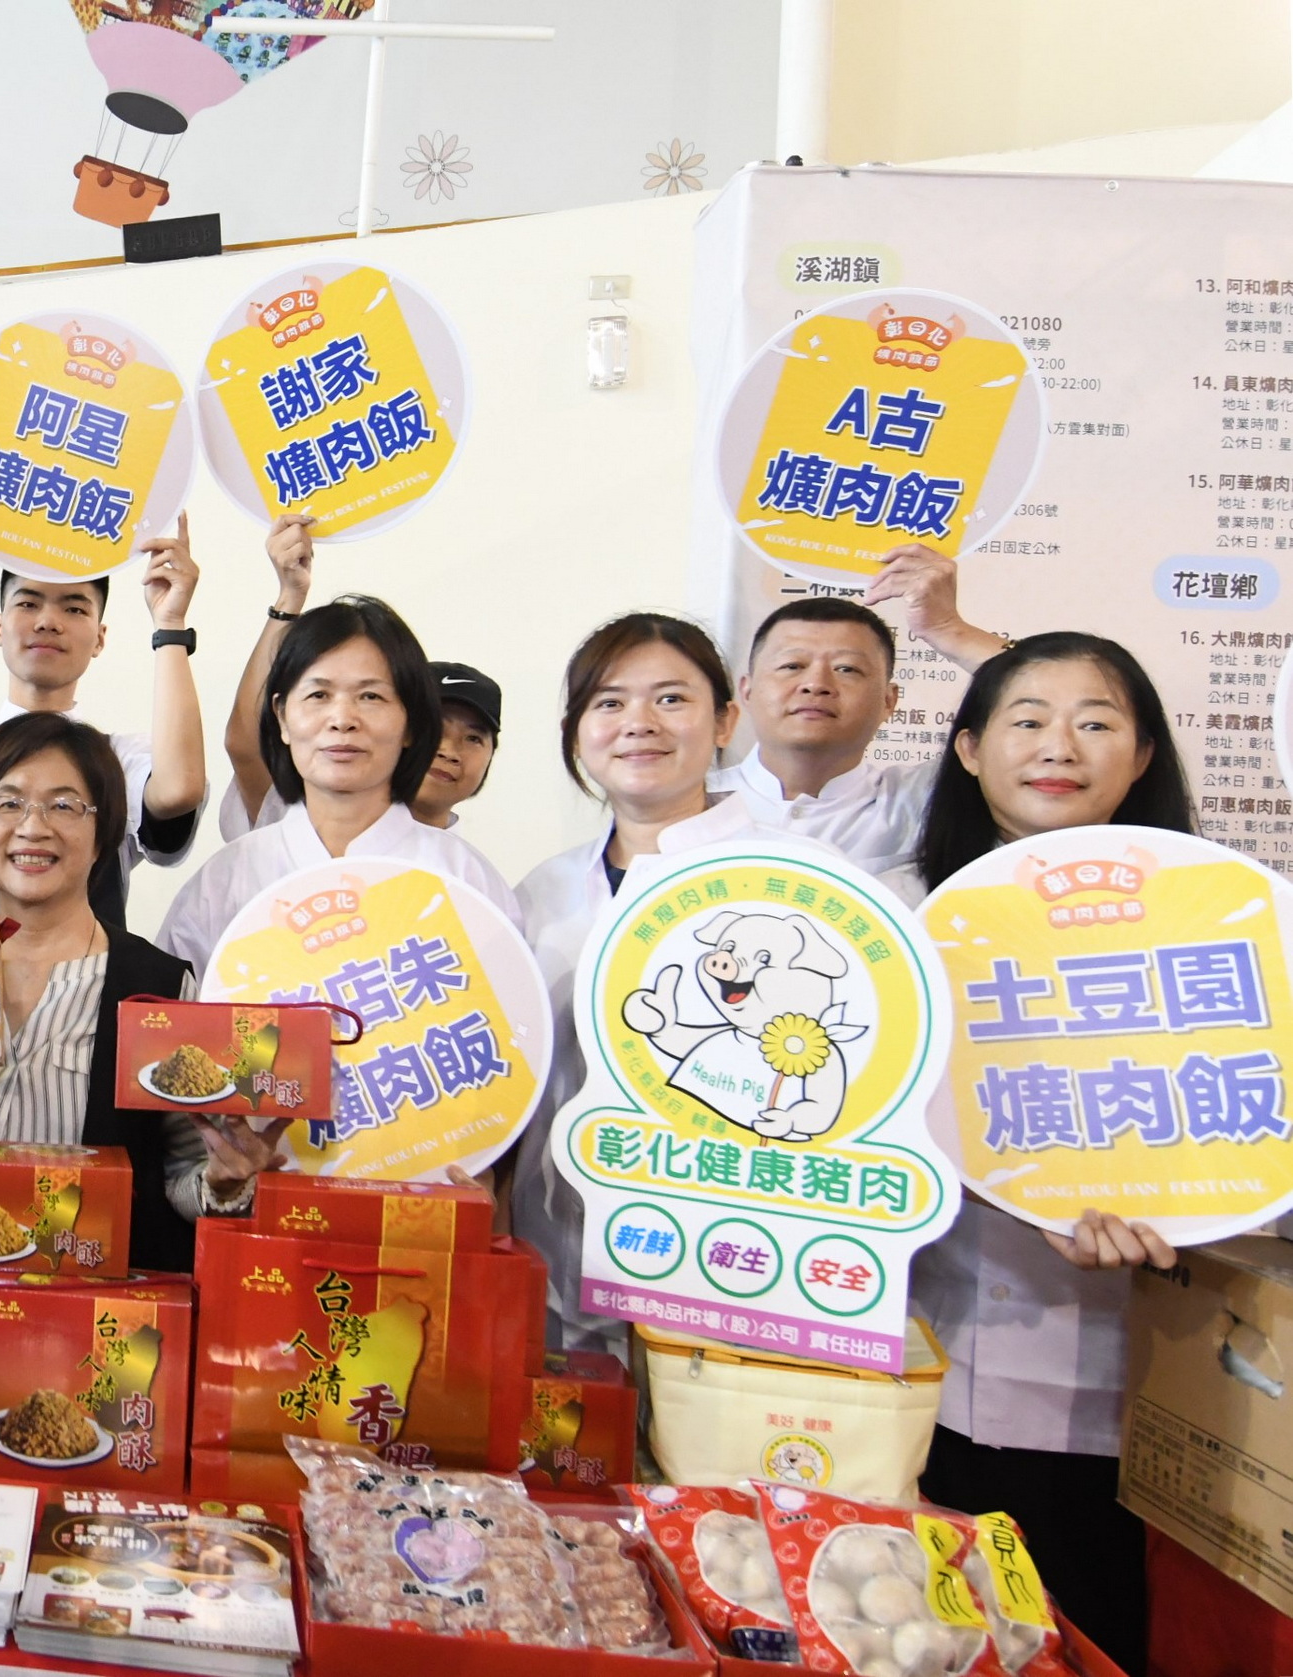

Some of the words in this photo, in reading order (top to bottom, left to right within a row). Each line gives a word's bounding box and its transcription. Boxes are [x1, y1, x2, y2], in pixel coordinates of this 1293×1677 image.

[794, 254, 881, 285] 溪湖鎮
[1195, 279, 1221, 294] 13.
[258, 333, 380, 429] 謝家
[1032, 358, 1065, 371] 2:00
[1192, 375, 1218, 391] 14.
[15, 384, 129, 468] 阿星
[825, 388, 945, 454] A古
[263, 388, 437, 506] 爌肉飯
[758, 449, 964, 539] 爌肉飯
[1187, 474, 1214, 490] 15.
[1218, 474, 1293, 492] 阿華爌肉
[1171, 570, 1258, 601] 花壇鄉
[1179, 630, 1206, 646] 16.
[889, 708, 926, 726] 肉飯
[1174, 713, 1201, 728] 17.
[965, 938, 1272, 1043] 土豆園
[144, 1011, 169, 1023] 上品
[252, 1069, 304, 1109] 肉酥
[689, 1059, 737, 1093] Health
[740, 1077, 766, 1104] Pig
[975, 1051, 1293, 1154] 爌肉飯
[596, 1124, 909, 1216] 彰化健康豬肉
[286, 1206, 322, 1222] 上品
[54, 1228, 104, 1268] 肉酥
[613, 1224, 675, 1260] 新鮮
[707, 1240, 771, 1276] 衛生
[247, 1266, 285, 1284] 上品
[805, 1258, 874, 1294] 安全
[315, 1271, 371, 1359] 台灣
[808, 1329, 892, 1364] 責任出品
[279, 1329, 347, 1422] 人情味
[117, 1392, 157, 1473] 肉酥
[553, 1445, 606, 1486] 肉酥
[62, 1490, 118, 1501] NEW
[63, 1499, 190, 1517] 新品上市
